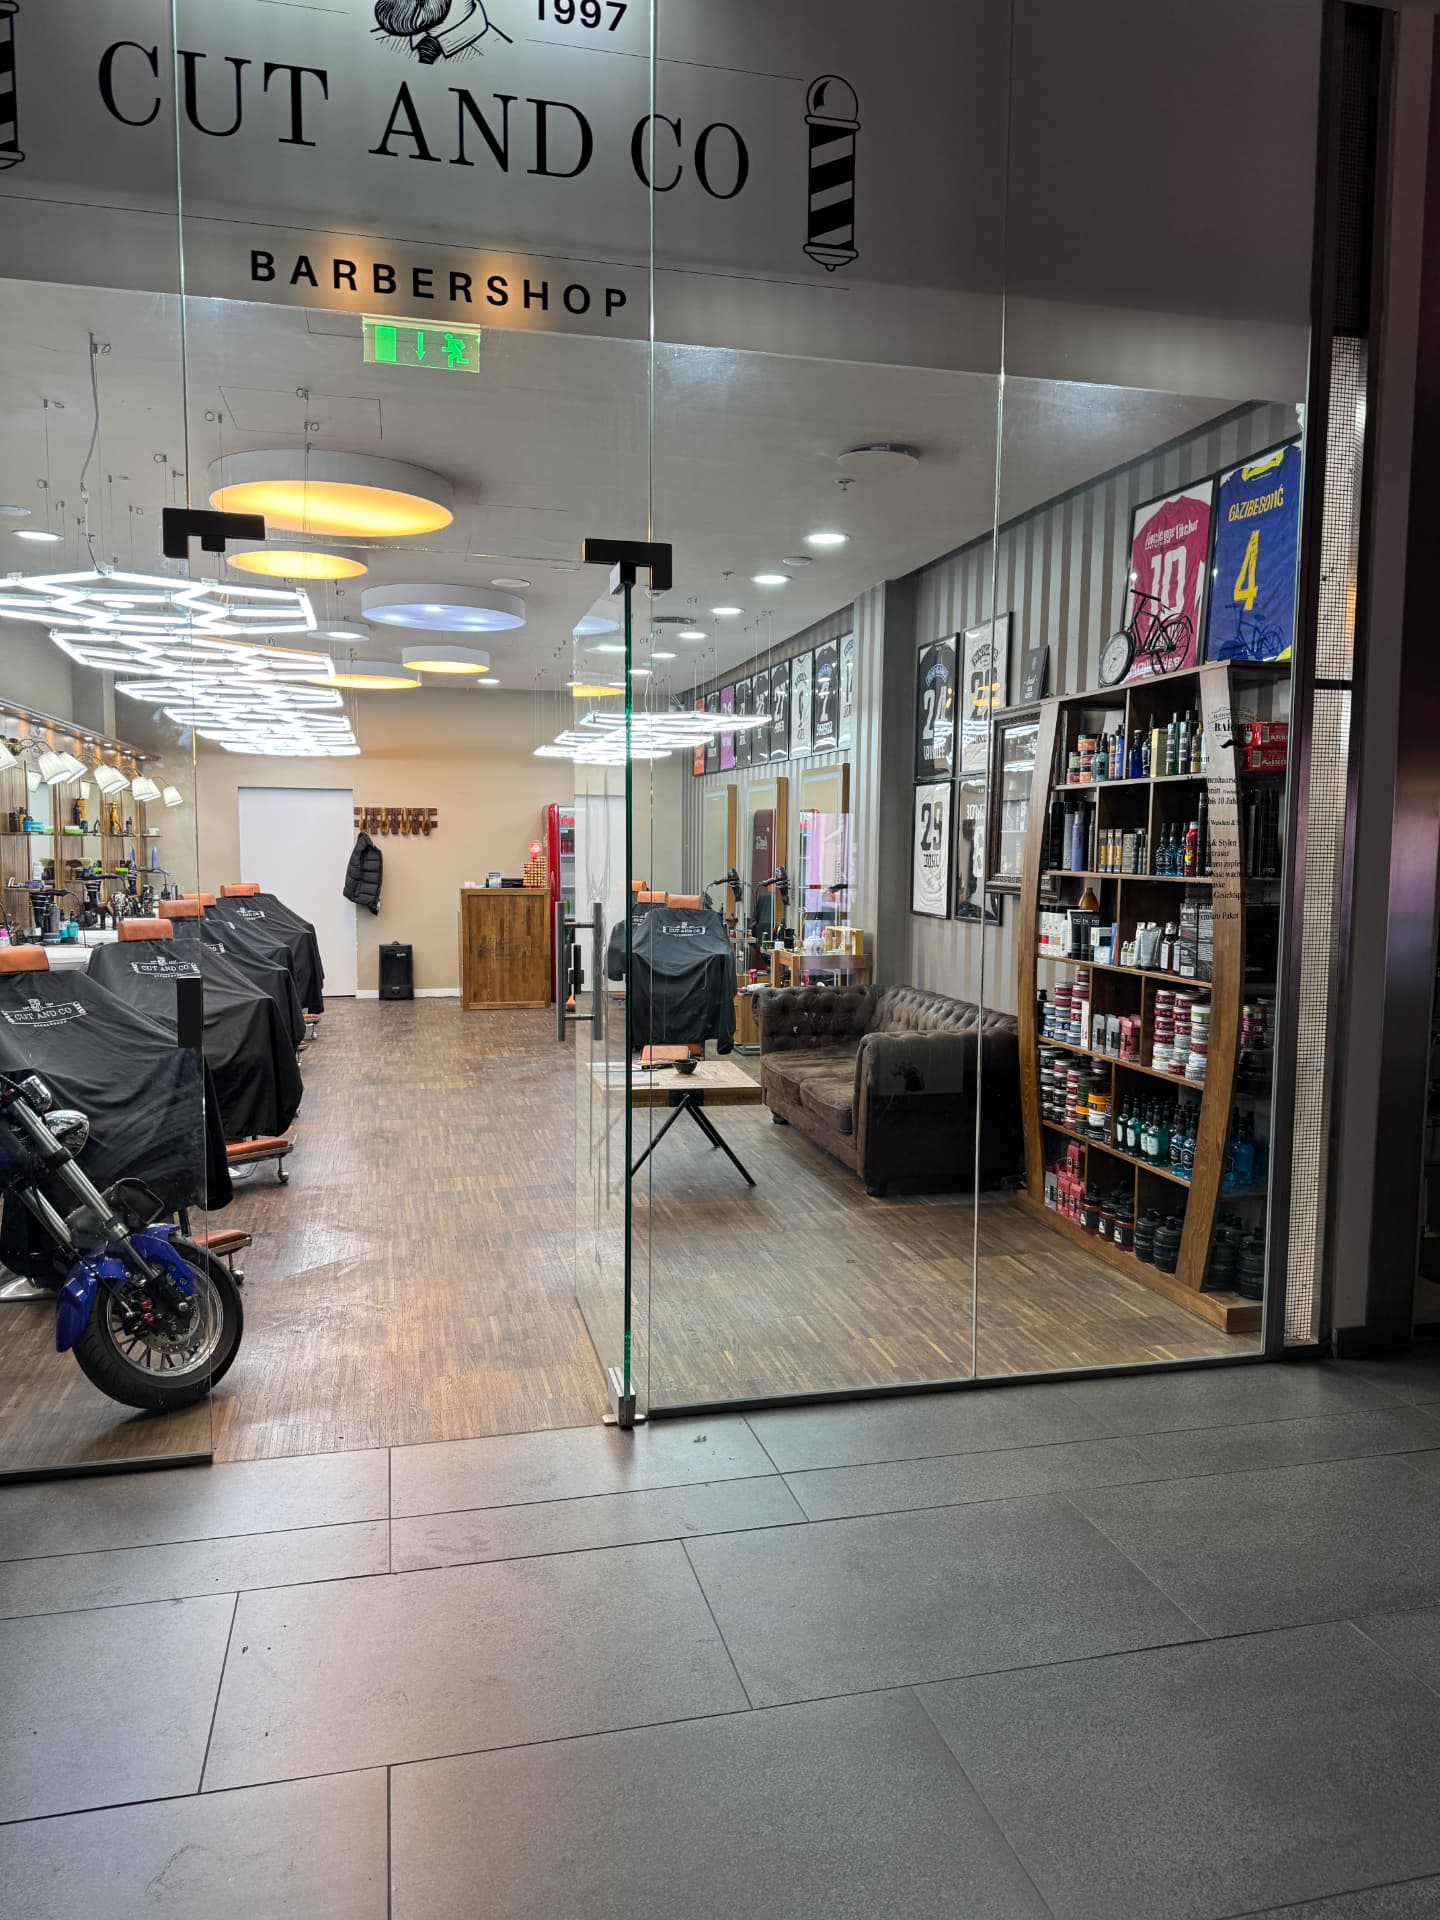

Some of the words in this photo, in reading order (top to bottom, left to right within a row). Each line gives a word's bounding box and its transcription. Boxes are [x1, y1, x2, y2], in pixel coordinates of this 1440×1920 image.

[538, 0, 628, 31] 1997
[97, 40, 329, 147] CUT
[368, 80, 594, 178] AND
[629, 113, 750, 200] CO
[250, 250, 628, 319] BARBERSHOP
[1150, 546, 1187, 626] 10
[1233, 529, 1260, 611] 4
[920, 800, 944, 851] 29
[58, 1007, 72, 1016] CO
